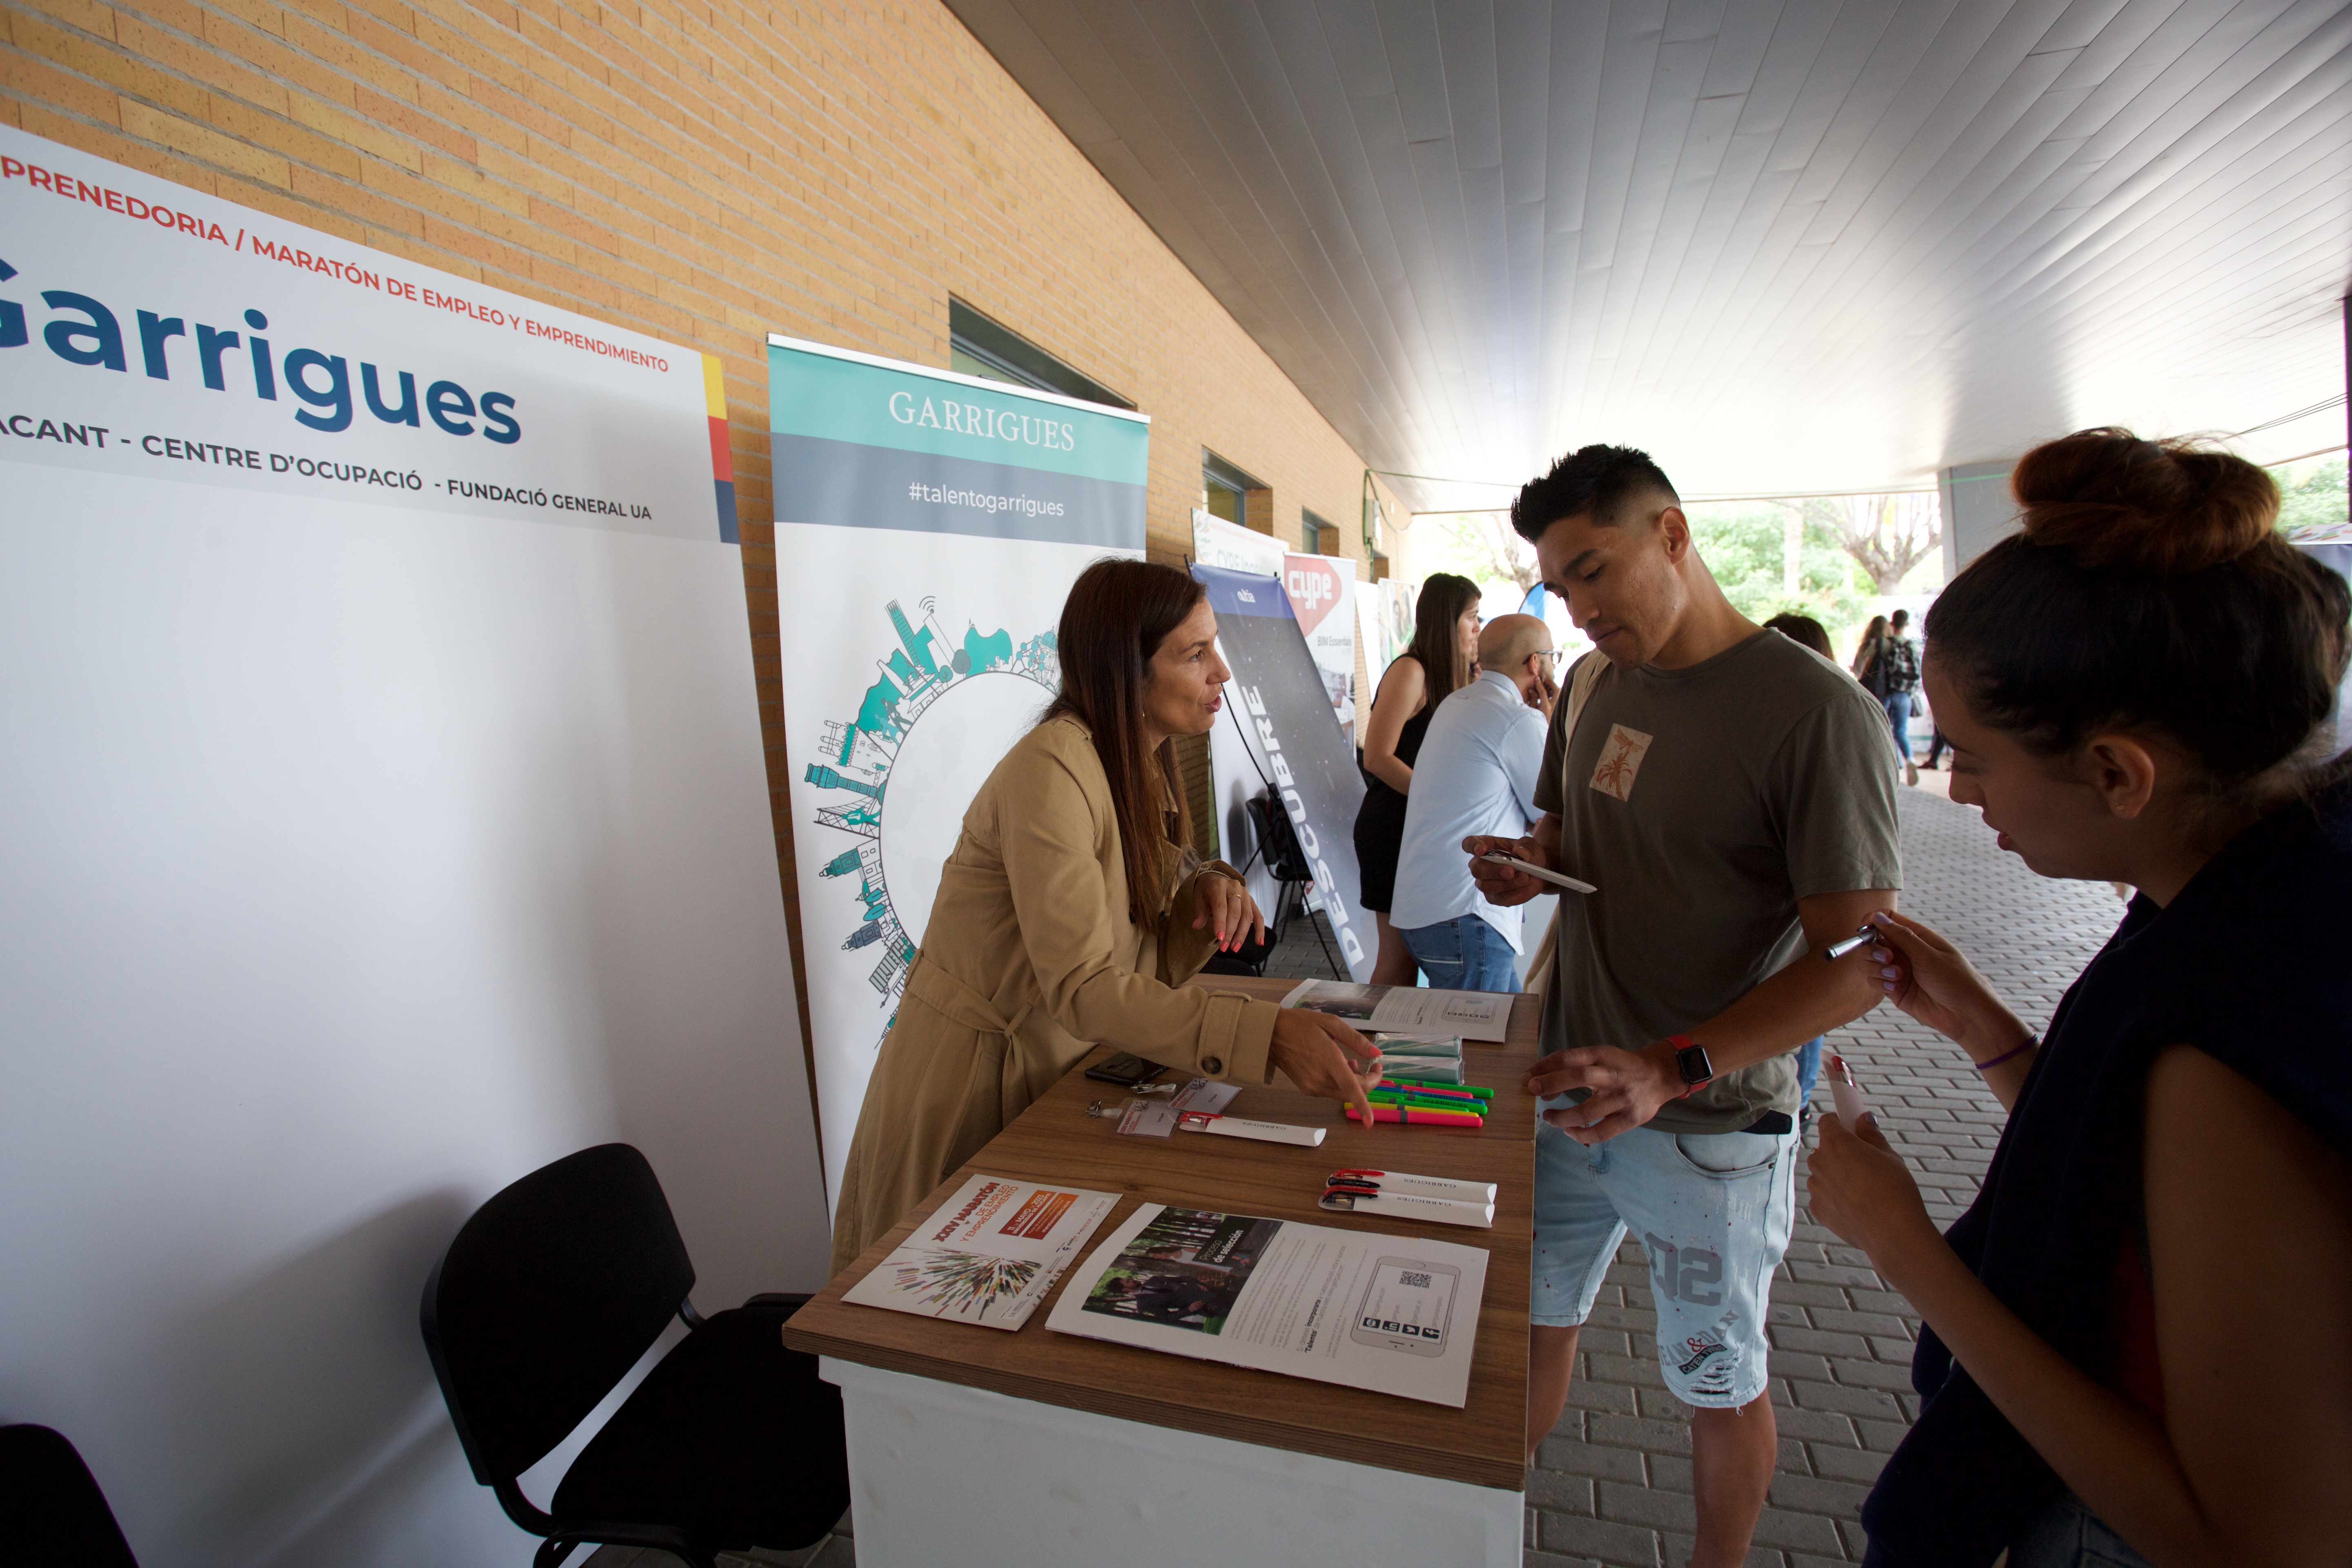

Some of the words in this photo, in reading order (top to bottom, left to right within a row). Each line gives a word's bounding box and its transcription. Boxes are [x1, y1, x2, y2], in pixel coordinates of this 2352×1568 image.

[1, 155, 229, 246] PRENEDORIA
[252, 236, 380, 291] MARATÓN
[387, 277, 417, 301] DE
[423, 288, 505, 325] EMPLEO
[509, 313, 520, 330] Y
[526, 319, 668, 372] EMPRENDIMIENTO
[0, 258, 521, 444] arrigues
[889, 391, 1075, 451] GARRIGUES
[142, 434, 263, 470] CENTRE
[448, 479, 547, 507] FUNDACIÓ
[552, 494, 627, 517] GENERAL
[630, 504, 652, 520] UA
[909, 482, 1064, 518] #talentogarrigues
[1288, 570, 1332, 610] cype
[1242, 686, 1364, 966] DESCUBRE
[1423, 1093, 1466, 1102] GARRIGUES
[1424, 1098, 1468, 1108] GARRIGUES
[1242, 1121, 1286, 1130] GARRIGUES
[1404, 1178, 1456, 1188] GARRIGUES
[931, 1221, 962, 1242] XXIV
[960, 1183, 1000, 1221] MARATÓN
[964, 1186, 1020, 1236] EMPRENDIMIENTO
[974, 1207, 989, 1216] DE
[986, 1185, 1011, 1207] EMPLEO
[1014, 1208, 1032, 1222] MAYO
[1030, 1194, 1045, 1205] 2023
[1397, 1196, 1451, 1207] GARRIGUES
[1198, 1239, 1223, 1260] Proceso
[1216, 1229, 1244, 1255] selección
[1211, 1254, 1226, 1263] de
[1304, 1299, 1323, 1327] incorporarte
[1695, 1309, 1739, 1344] DAN
[1687, 1337, 1708, 1353] &
[1682, 1354, 1705, 1373] CATEN
